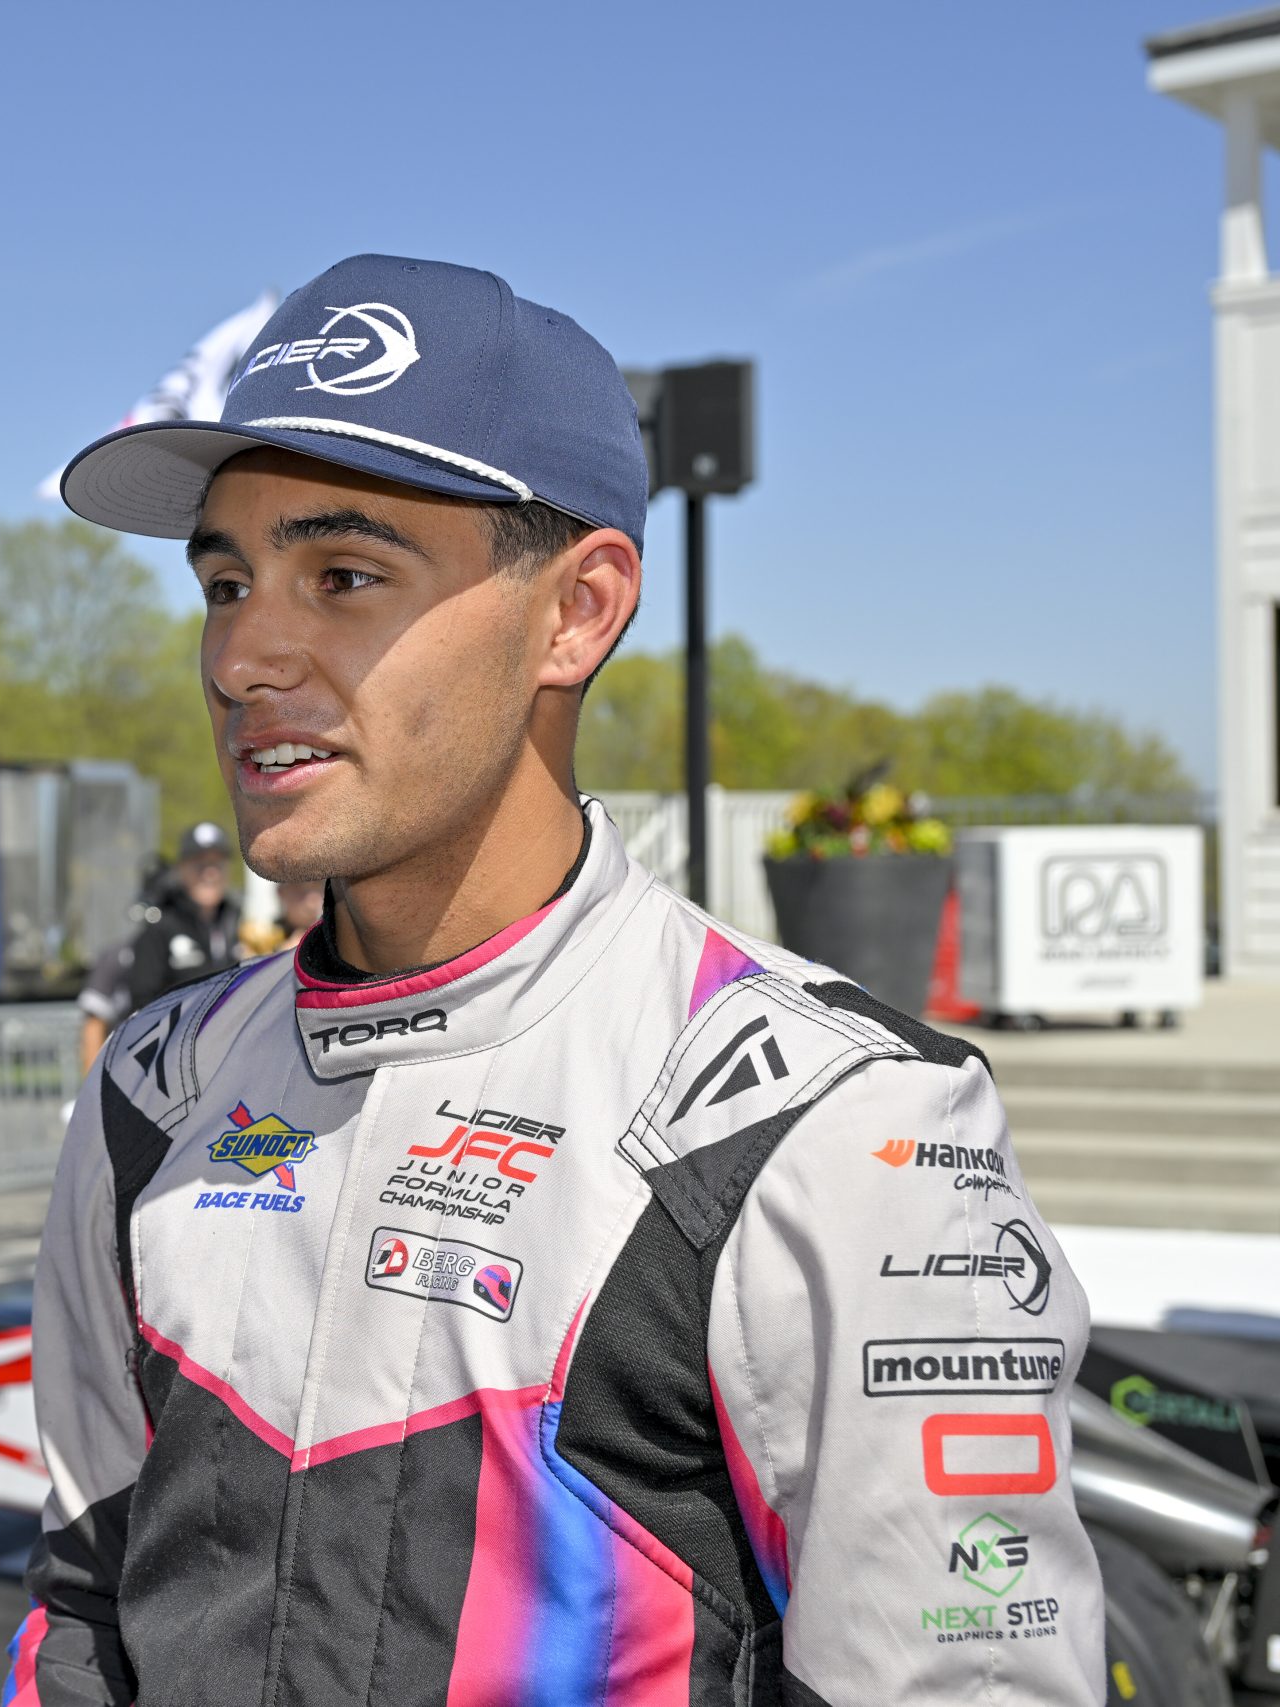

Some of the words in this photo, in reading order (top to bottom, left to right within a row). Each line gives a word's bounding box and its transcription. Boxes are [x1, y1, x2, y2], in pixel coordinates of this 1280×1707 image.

[309, 1008, 448, 1054] TORQ
[436, 1100, 566, 1144] LIGIER
[215, 1134, 310, 1159] SUNOCO
[407, 1125, 555, 1183] JFC
[387, 1175, 511, 1213] FORMULA
[397, 1160, 525, 1197] JUNIOR
[193, 1191, 251, 1210] RACE
[250, 1193, 305, 1213] FUELS
[412, 1247, 476, 1276] BERG
[880, 1254, 1026, 1279] LIGIER
[873, 1349, 1061, 1382] mountune
[949, 1534, 1029, 1575] NXS
[921, 1605, 997, 1630] NEXT
[1006, 1597, 1059, 1626] STEP
[937, 1629, 1004, 1643] GRAPHICS
[1009, 1629, 1019, 1640] &
[1023, 1626, 1057, 1639] SIGNS
